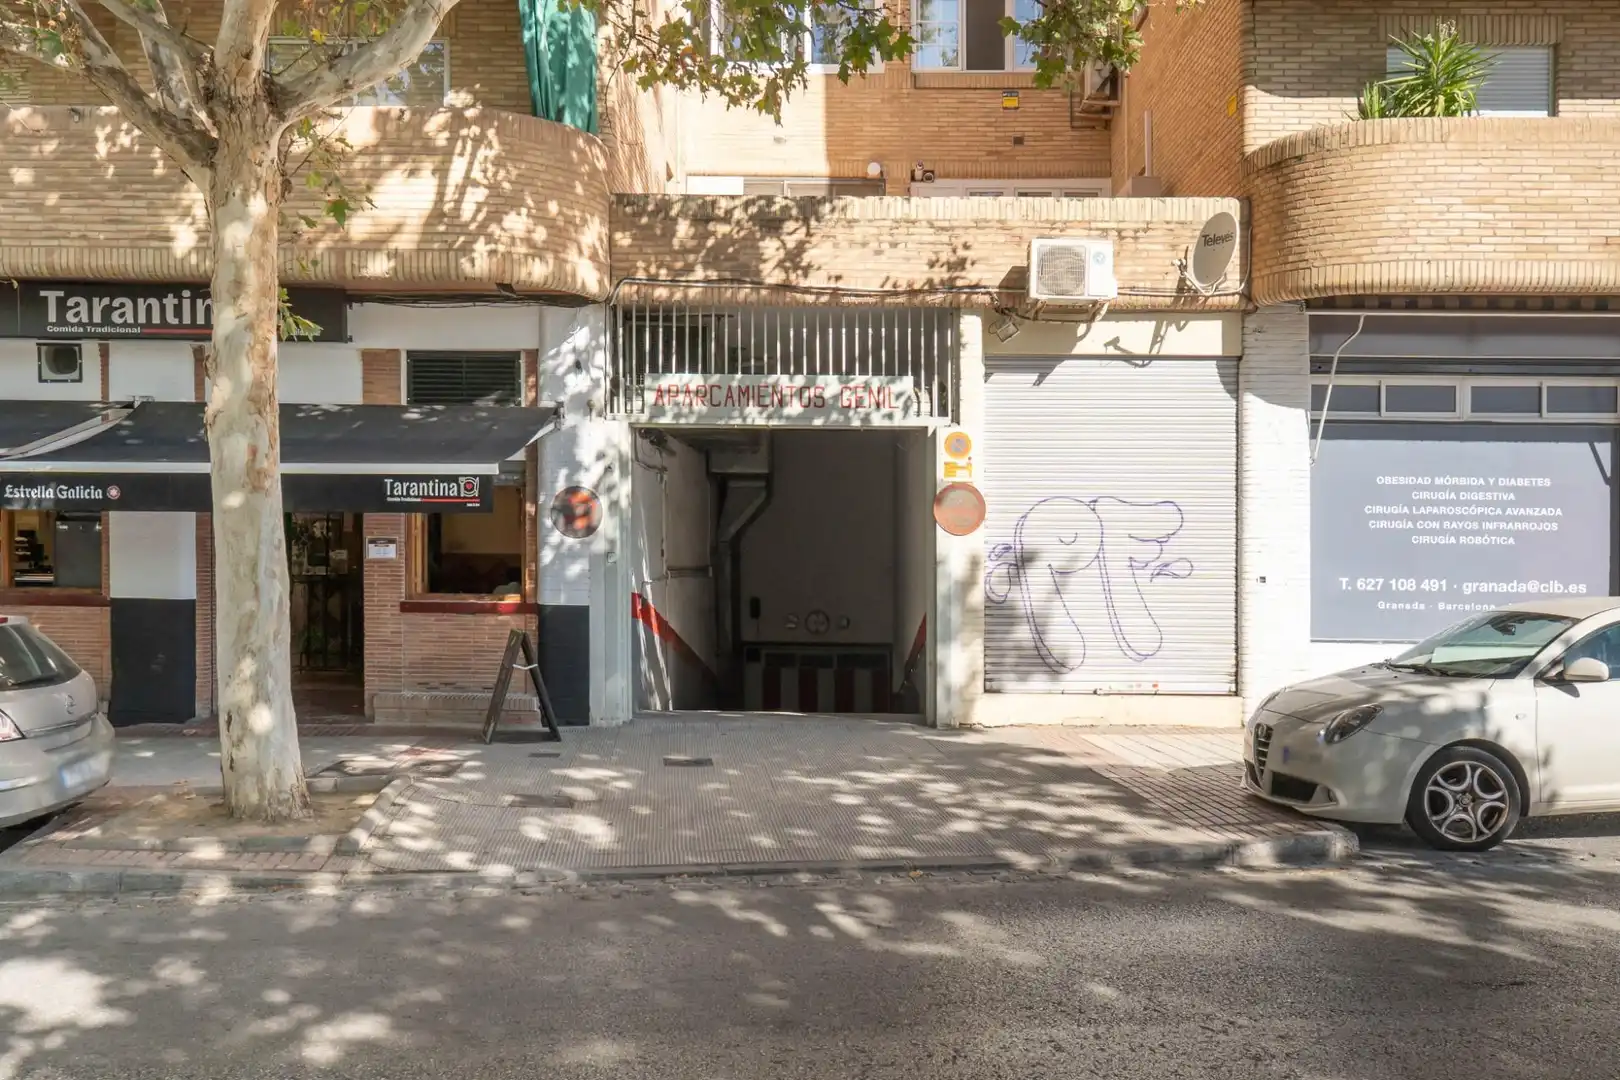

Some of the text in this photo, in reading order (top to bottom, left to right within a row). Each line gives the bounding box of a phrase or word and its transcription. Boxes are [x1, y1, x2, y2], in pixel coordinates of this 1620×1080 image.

[39, 289, 213, 325] Tarantin
[46, 325, 141, 334] Comida Tradicional
[653, 383, 901, 410] APARCAMIENTOS GENIL
[384, 478, 458, 496] Tarantina
[1376, 475, 1552, 487] OBESIDAD MÓRBIDA Y DIABETES
[3, 484, 103, 499] Estrella Galicia
[1411, 490, 1516, 501] CIRUGÍA DIGESTIVA
[1364, 504, 1563, 516] CIRUGÍA LAPAROSCÓPICA AVANZADA
[1368, 519, 1559, 531] CIRUGÍA CON RAYOS INFRARROJOS
[1411, 533, 1515, 545] CIRUGÍA ROBÓTICA
[1339, 577, 1588, 595] T. 627 108 491 granada@cib.es
[1377, 601, 1425, 611] Granada
